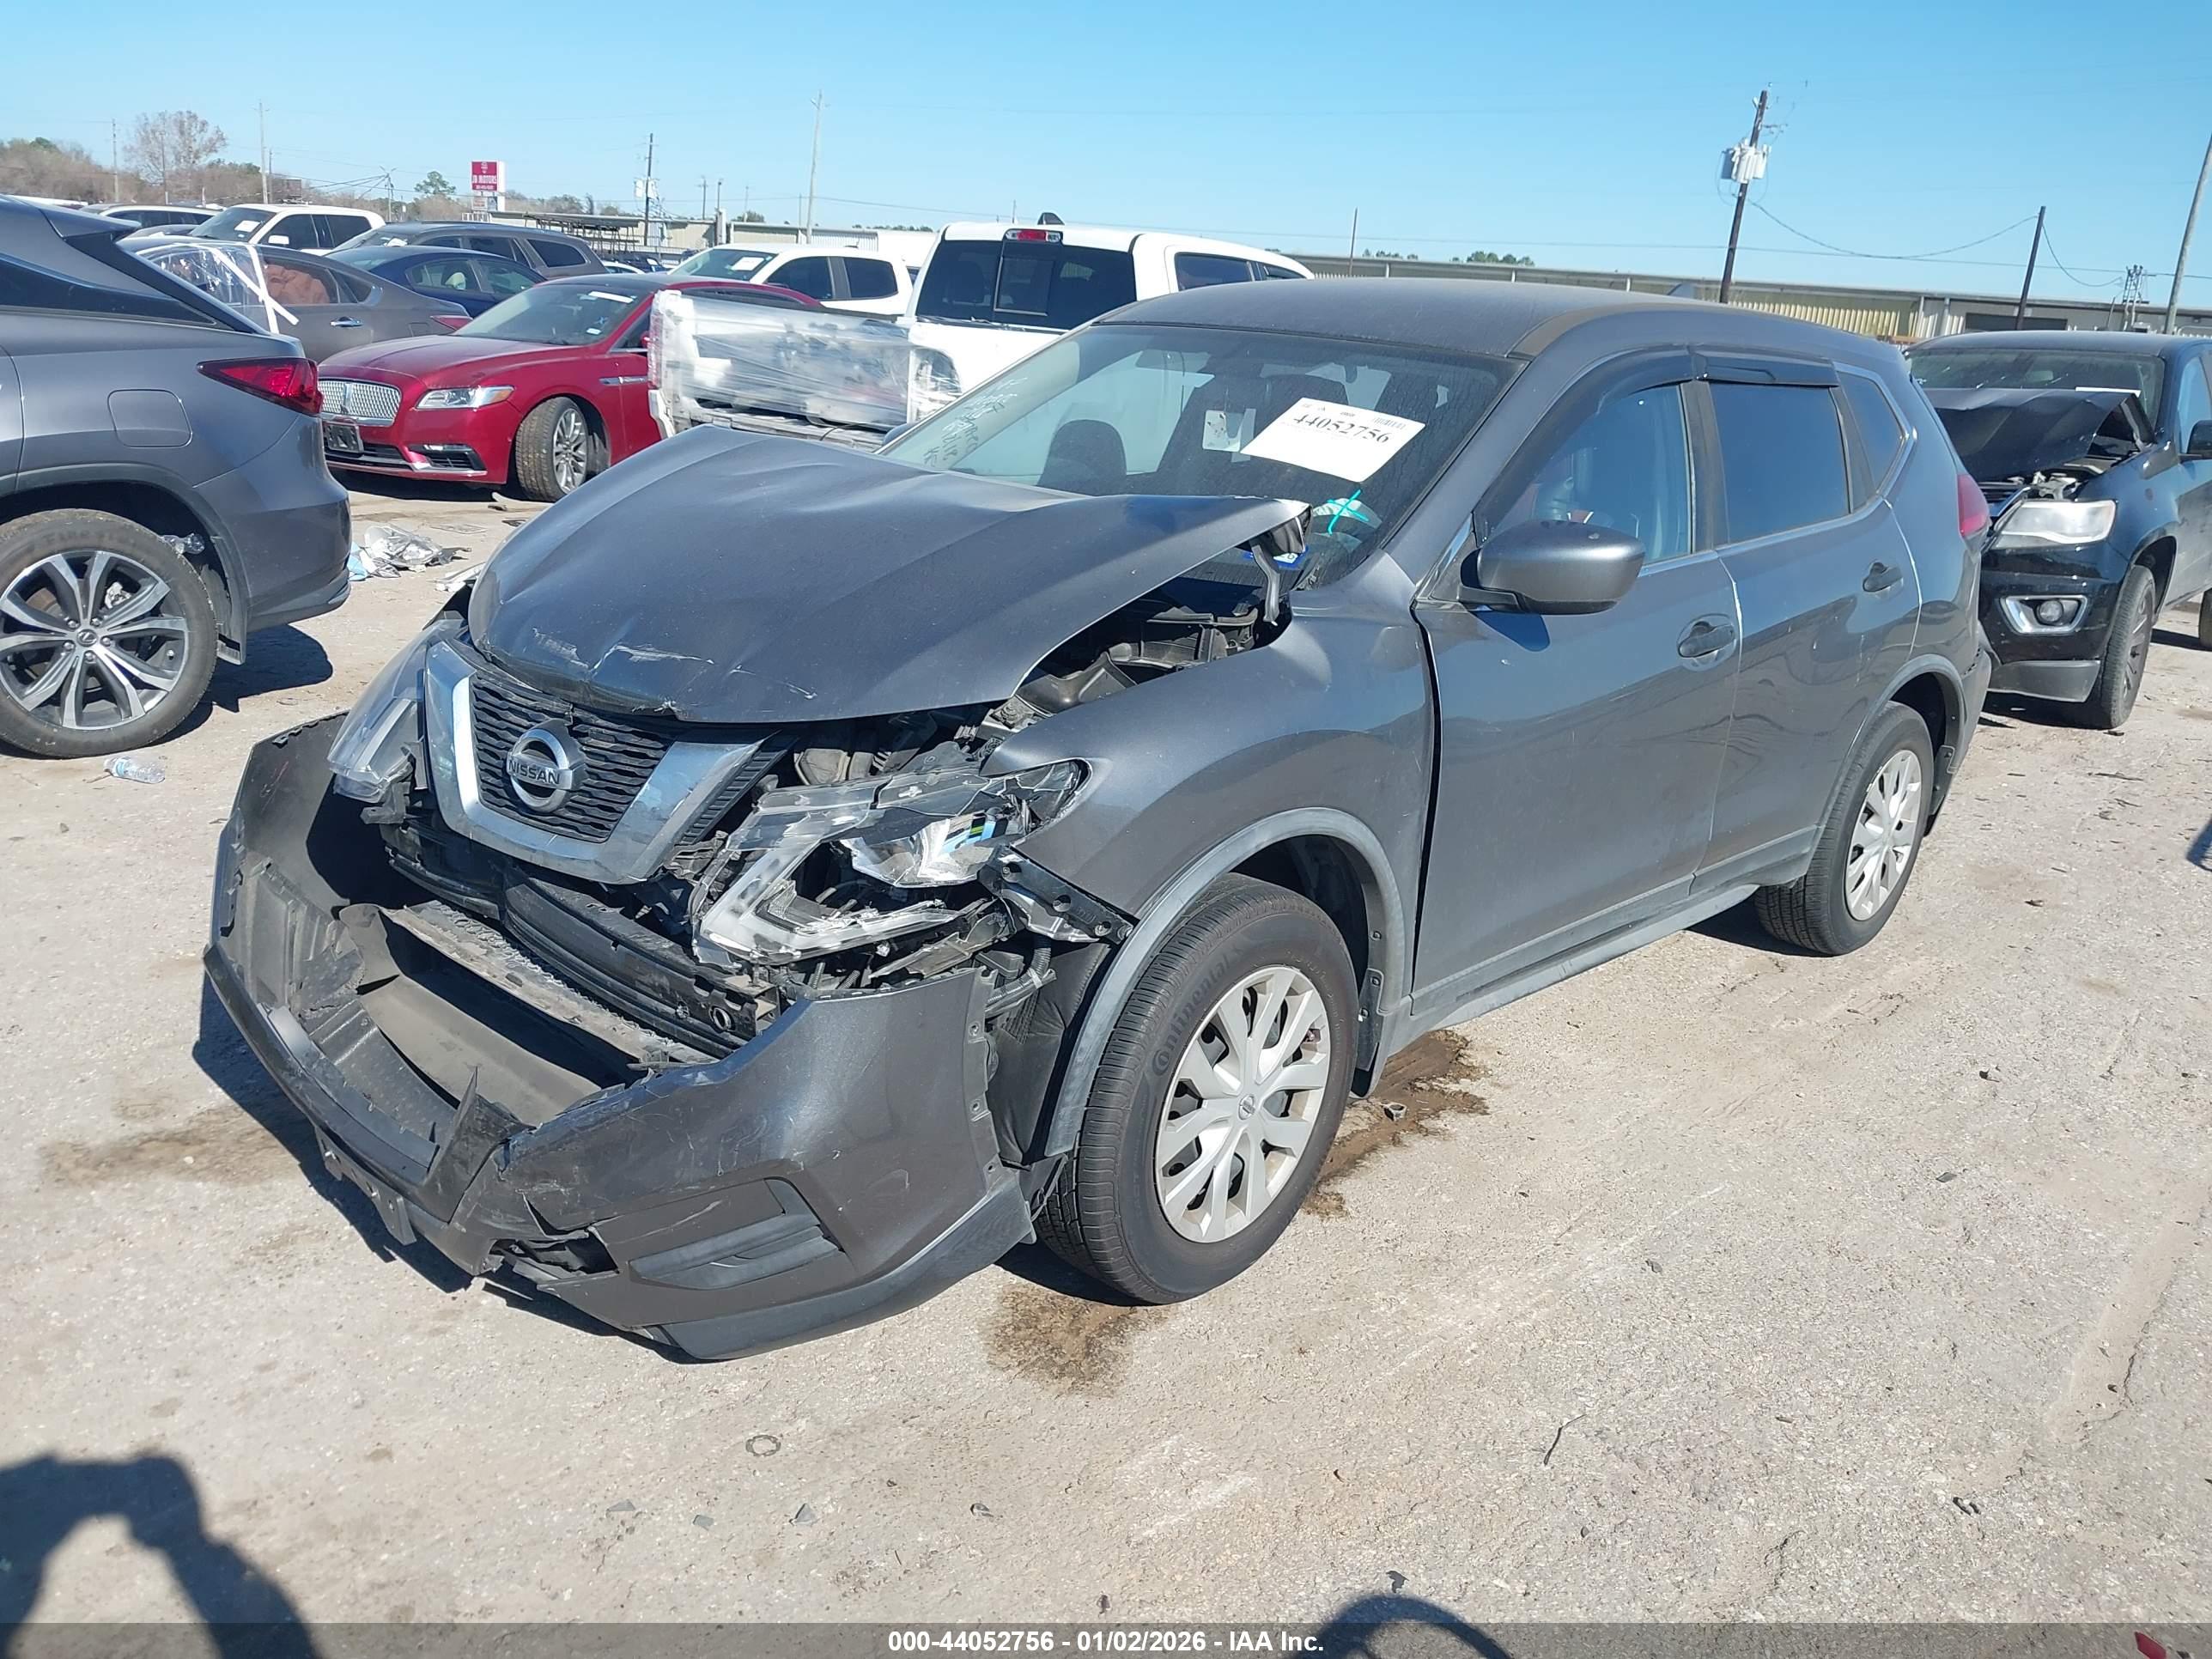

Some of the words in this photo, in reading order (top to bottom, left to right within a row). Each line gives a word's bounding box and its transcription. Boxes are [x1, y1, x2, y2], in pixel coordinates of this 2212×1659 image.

[1293, 413, 1390, 443] 44052756
[507, 759, 561, 785] NISSAN
[1151, 954, 1233, 1077] Continental
